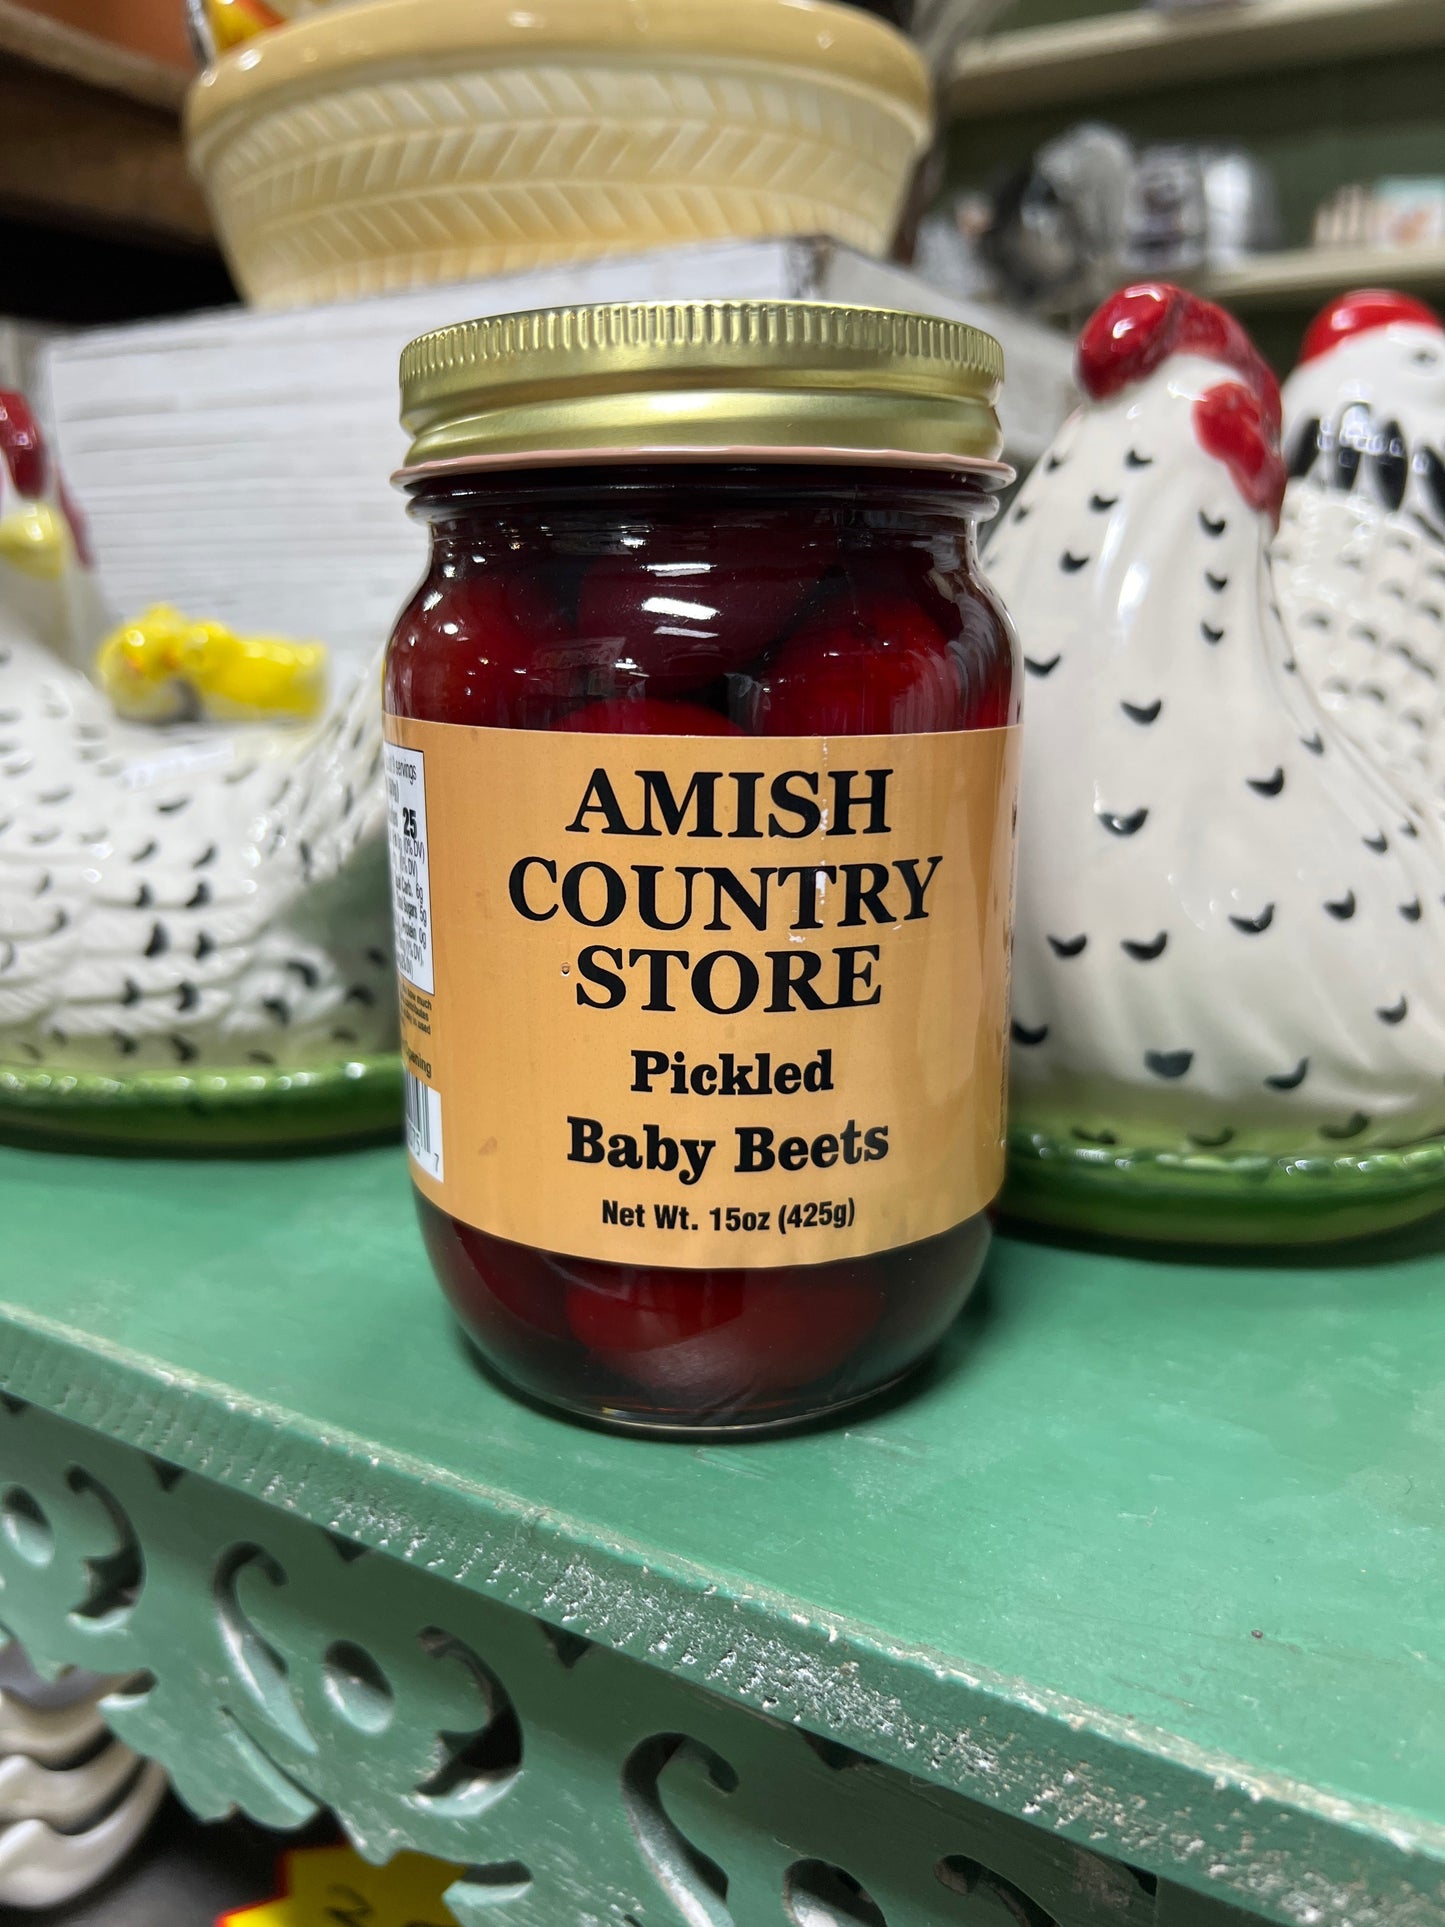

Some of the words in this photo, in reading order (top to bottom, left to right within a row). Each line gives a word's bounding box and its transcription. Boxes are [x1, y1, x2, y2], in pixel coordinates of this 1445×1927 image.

[403, 807, 417, 840] 25
[565, 767, 894, 839] AMISH
[508, 855, 944, 931] COUNTRY
[576, 944, 882, 1015] STORE
[630, 1048, 835, 1096] Pickled
[567, 1115, 717, 1186] Baby
[734, 1119, 889, 1173] Beets
[602, 1199, 646, 1228] Net
[653, 1203, 699, 1231] Wt.
[709, 1206, 771, 1232] 15oz
[778, 1197, 855, 1235] (425g)
